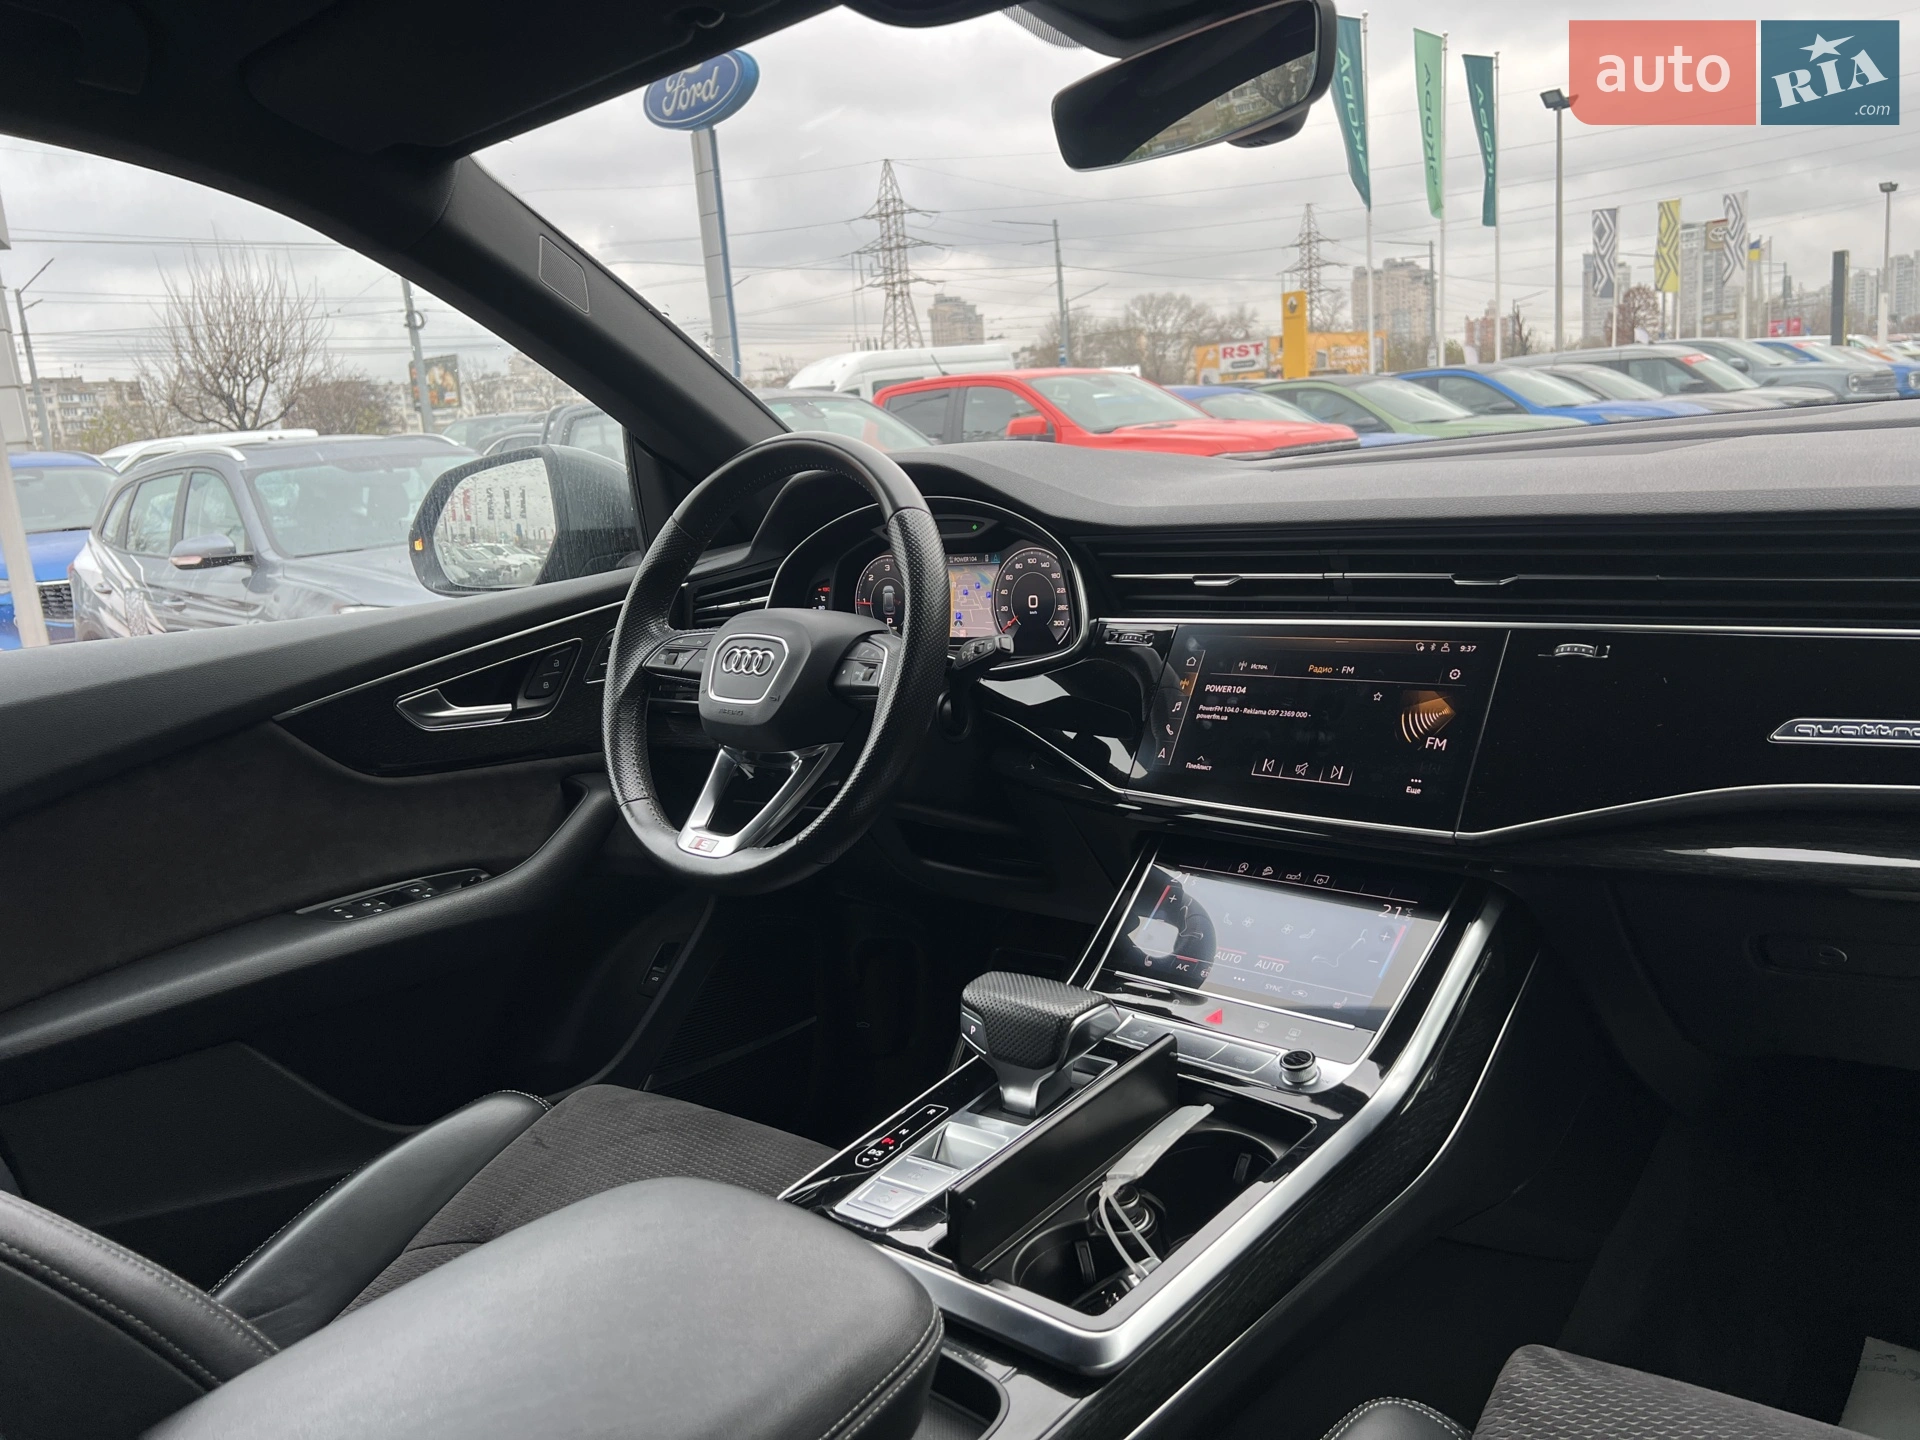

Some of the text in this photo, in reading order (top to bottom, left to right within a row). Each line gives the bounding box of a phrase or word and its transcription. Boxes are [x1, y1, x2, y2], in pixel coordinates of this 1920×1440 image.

[661, 63, 720, 117] Ford
[1222, 343, 1264, 359] RST
[1028, 595, 1038, 608] 0
[887, 617, 893, 626] P
[1459, 645, 1477, 653] 9:37
[1308, 664, 1355, 674] Радио FM
[1204, 683, 1247, 694] POWER104
[1198, 704, 1224, 713] PowerFM
[1224, 706, 1240, 714] 104.0
[1242, 707, 1267, 716] Reklama
[1279, 710, 1295, 718] 2369
[1295, 711, 1308, 719] 000
[1195, 713, 1229, 721] powerfm.ua
[1425, 736, 1448, 751] FM
[1185, 762, 1213, 771] Плейлист
[1405, 785, 1422, 795] Еще
[1378, 903, 1402, 920] 21
[1213, 951, 1242, 964] AUTO
[1175, 963, 1190, 972] A/C
[1254, 960, 1285, 973] AUTO
[1264, 983, 1283, 993] SYNC
[970, 1025, 976, 1035] P
[899, 1128, 910, 1136] N
